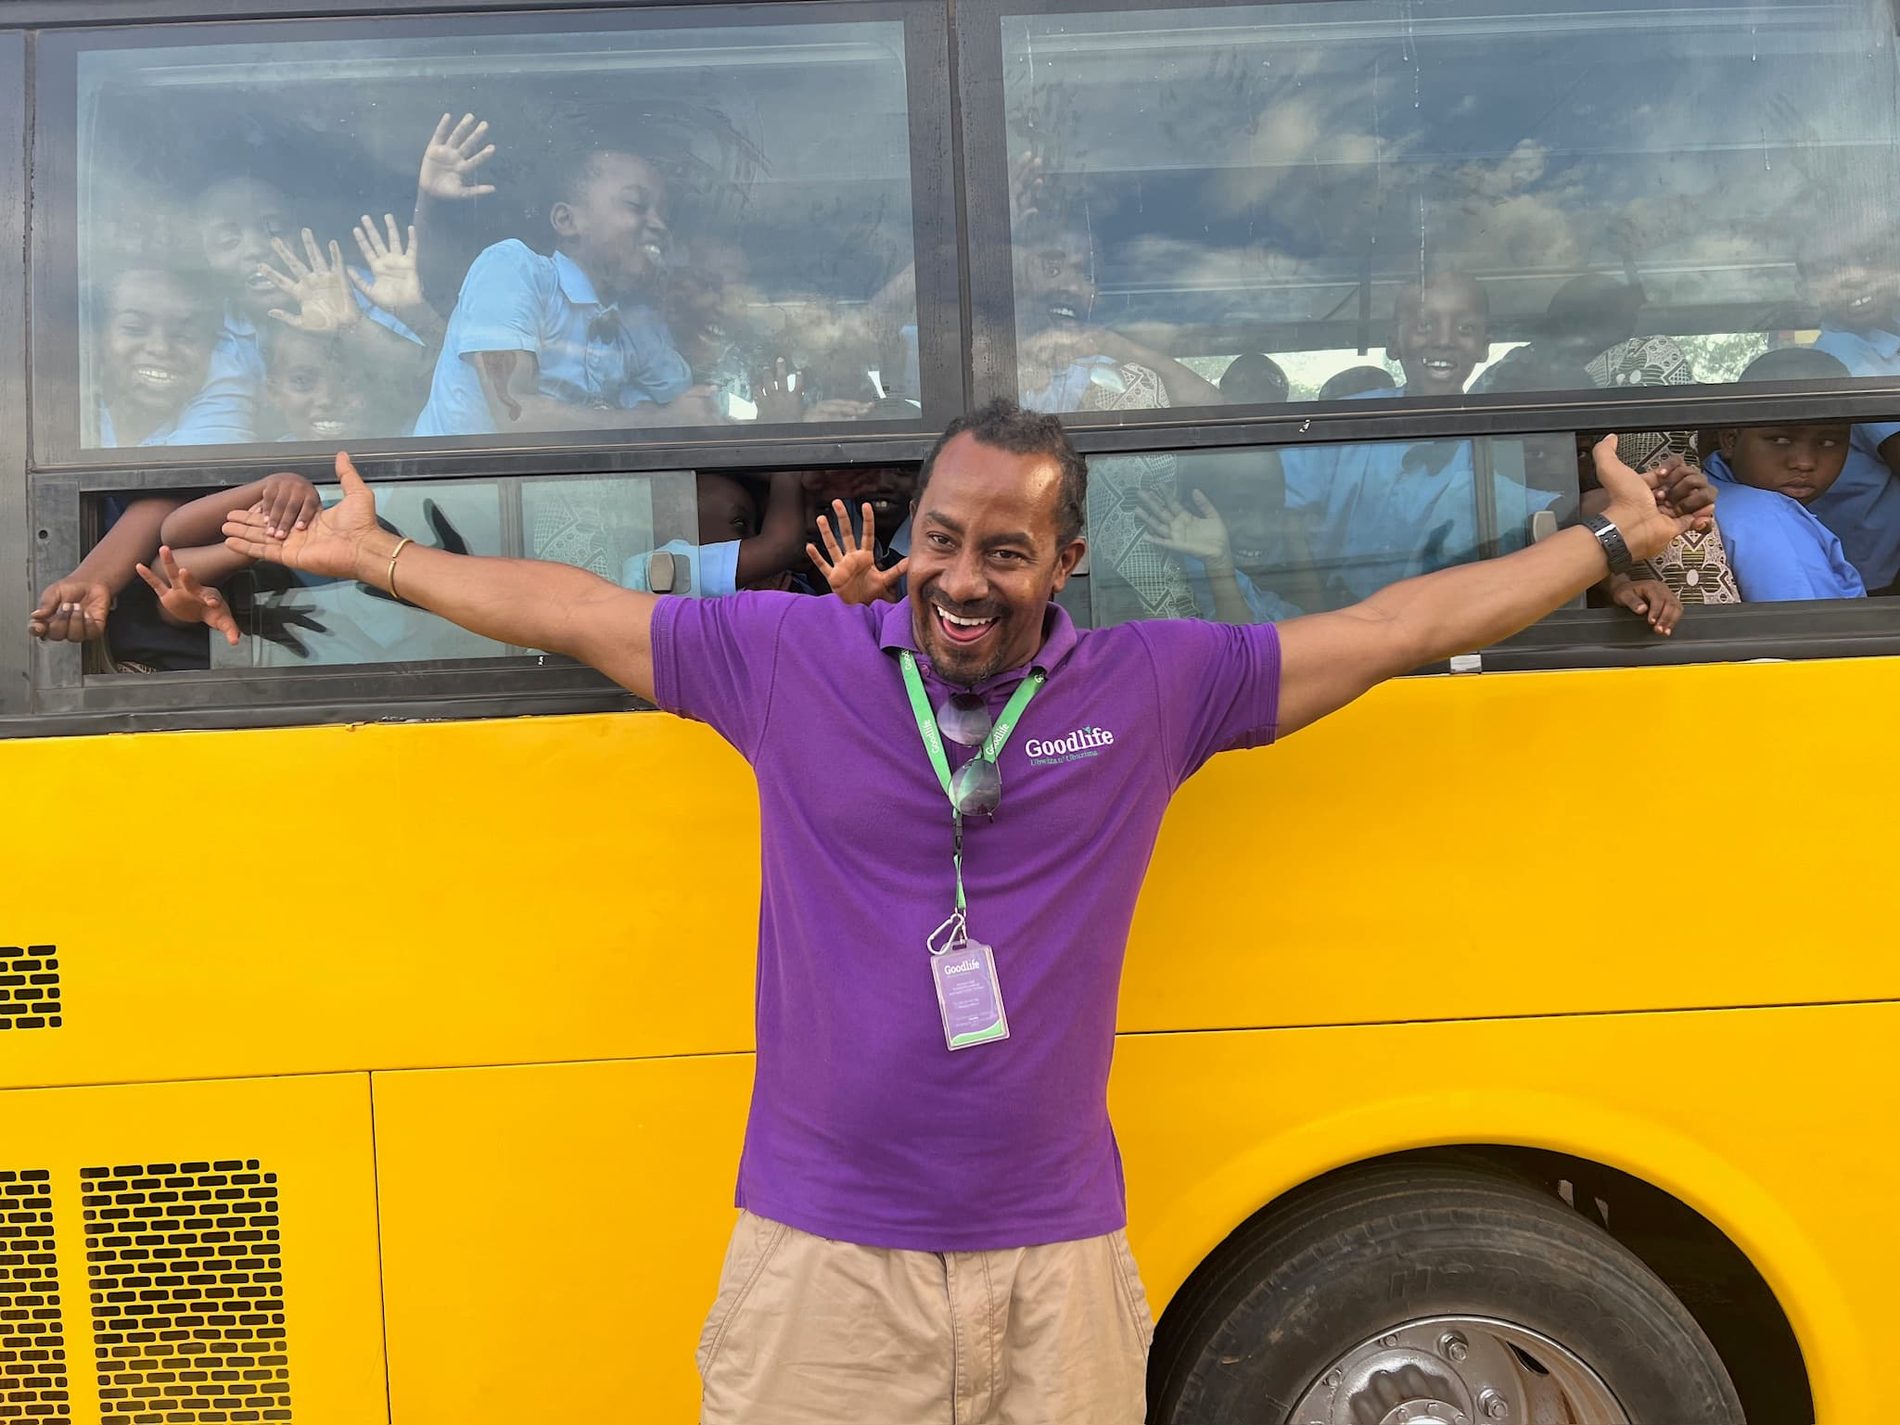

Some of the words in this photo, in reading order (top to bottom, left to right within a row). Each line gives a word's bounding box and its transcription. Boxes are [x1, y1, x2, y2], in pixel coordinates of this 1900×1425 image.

[923, 719, 939, 753] Goodlife
[985, 723, 1010, 755] Goodlife
[1025, 727, 1115, 758] Goodlife
[944, 959, 980, 975] Goodlife
